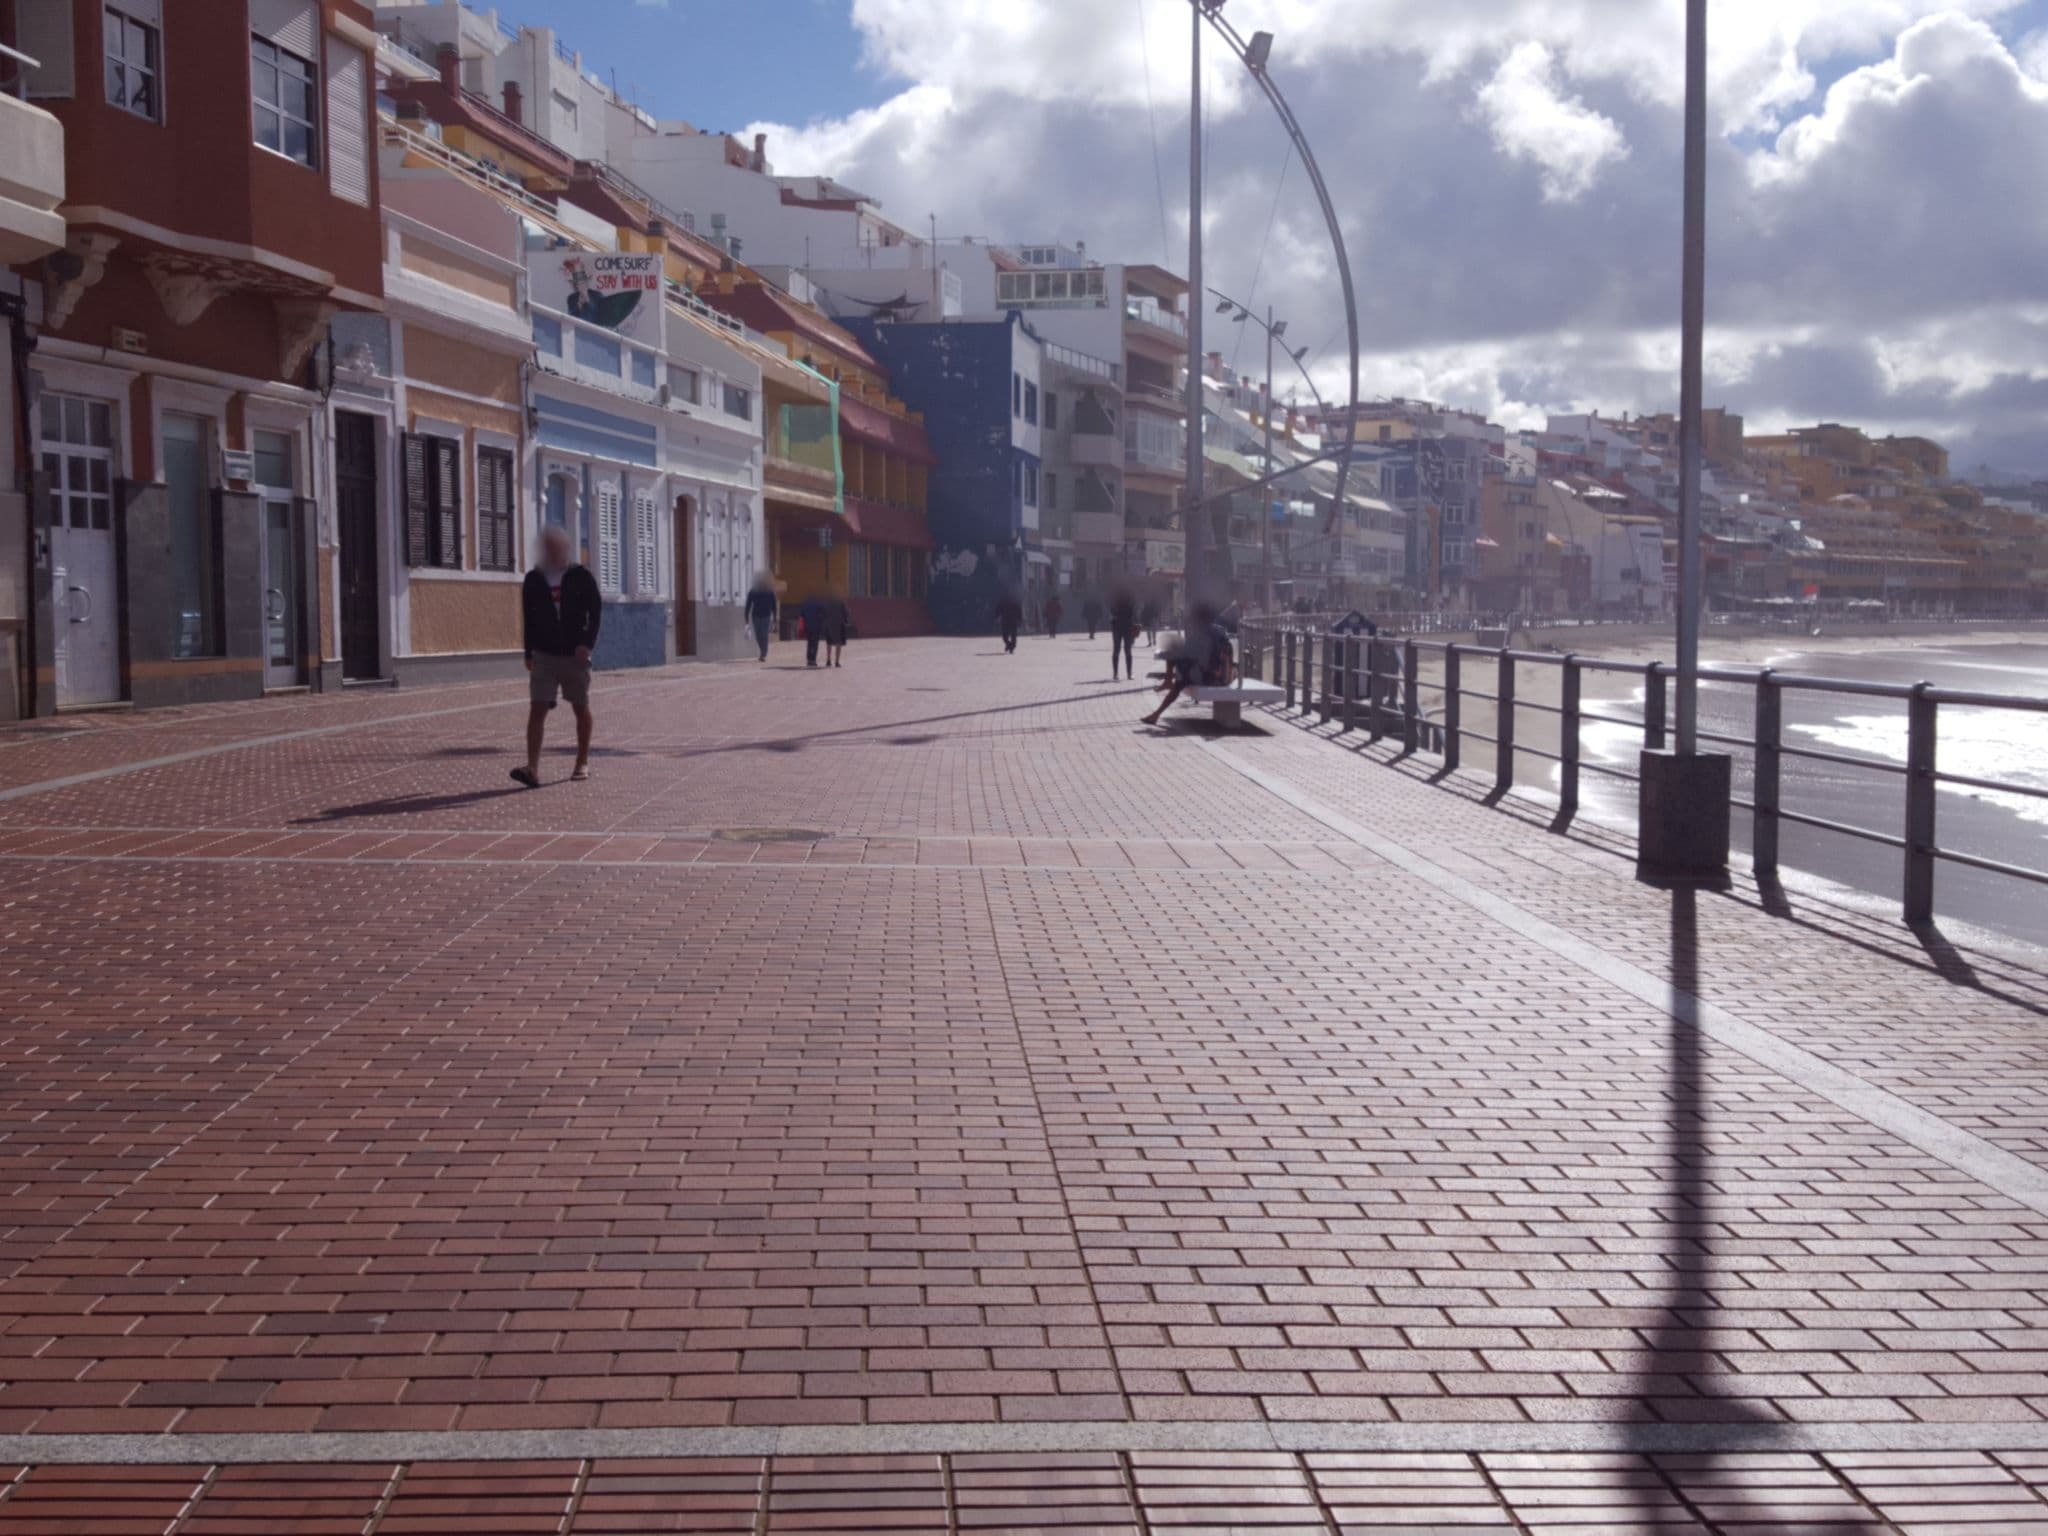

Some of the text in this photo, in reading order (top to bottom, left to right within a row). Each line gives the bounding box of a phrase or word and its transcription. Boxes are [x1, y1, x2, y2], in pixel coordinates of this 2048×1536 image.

[595, 257, 652, 270] COME SURF
[596, 275, 657, 290] STAY WITH US
